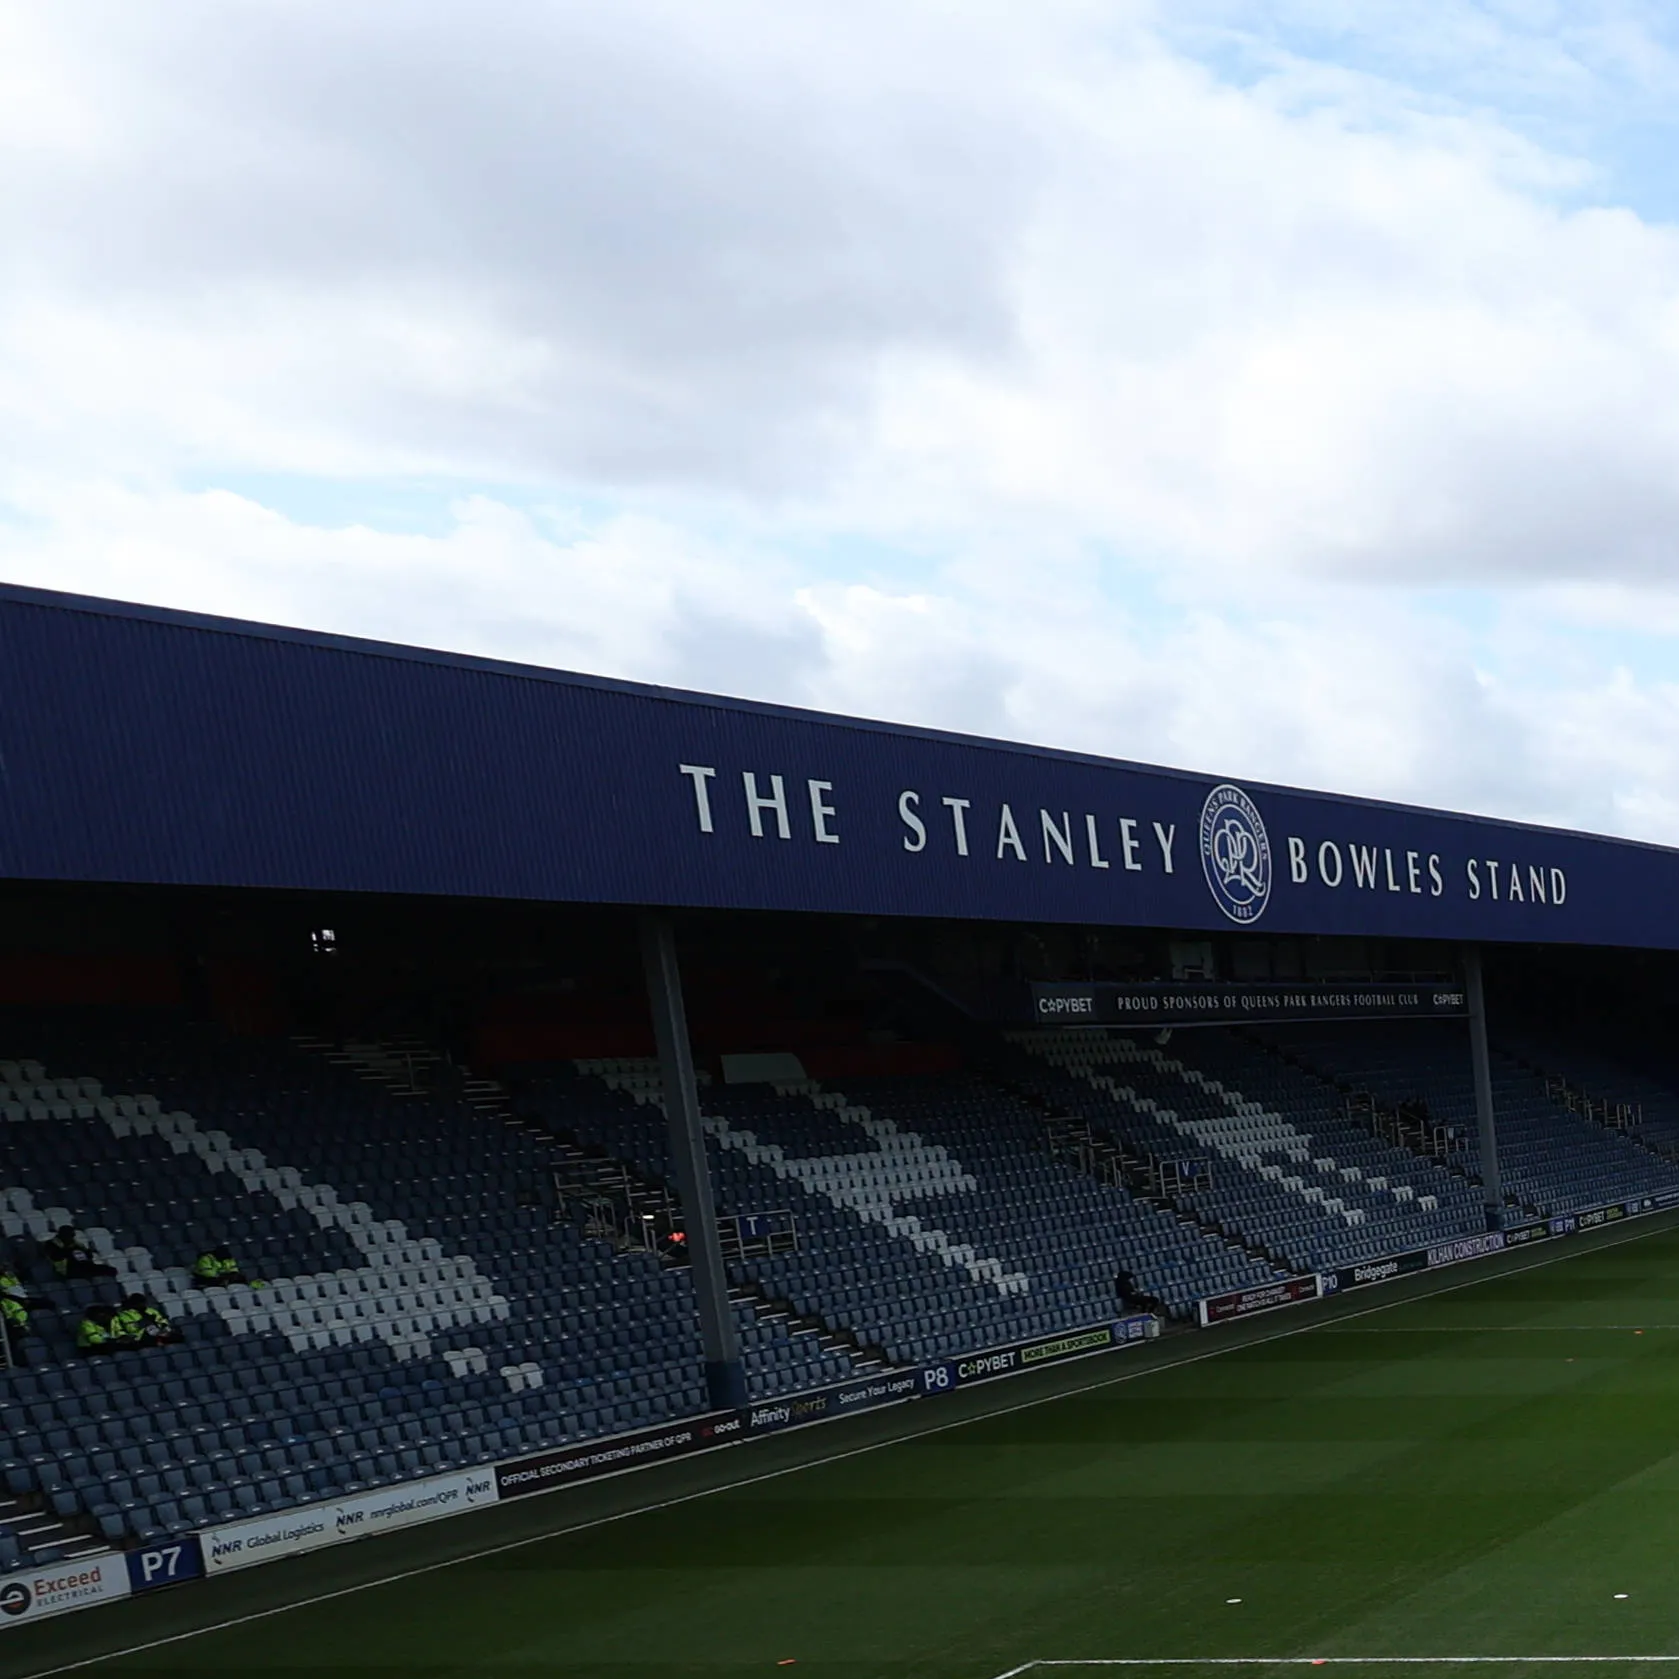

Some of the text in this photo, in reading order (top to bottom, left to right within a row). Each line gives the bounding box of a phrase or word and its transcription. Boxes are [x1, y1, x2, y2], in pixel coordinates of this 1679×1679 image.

[680, 763, 1567, 905] THE STANLEY BOWLES STAND
[1117, 993, 1419, 1011] PROUD SPONSORS OF QUEENS PARK RANGERS FOOTBALL CLUB
[745, 1216, 759, 1236] T
[1426, 1234, 1505, 1267] KILHAN CONSTRUCTION
[1354, 1260, 1398, 1281] Bridgegate
[1023, 1348, 1043, 1361] MORE
[1044, 1344, 1061, 1357] THAN
[1066, 1332, 1108, 1352] SPORTSBOOK
[838, 1377, 916, 1405] Secure Your Legacy
[923, 1366, 950, 1391] P8
[750, 1404, 791, 1428] Affinity
[500, 1470, 540, 1488] OFFICIAL
[540, 1459, 589, 1479] SECONDARY
[588, 1447, 630, 1466] TICKETING
[630, 1438, 666, 1458] PARTNER
[665, 1435, 677, 1448] OF
[210, 1538, 243, 1559] NNR
[246, 1529, 282, 1549] Global
[282, 1521, 325, 1542] Logistics
[335, 1509, 365, 1528] NNR
[465, 1479, 491, 1497] NNR
[141, 1545, 183, 1582] P7
[34, 1566, 102, 1597] Exceed
[37, 1585, 105, 1608] ELECTRICAL
